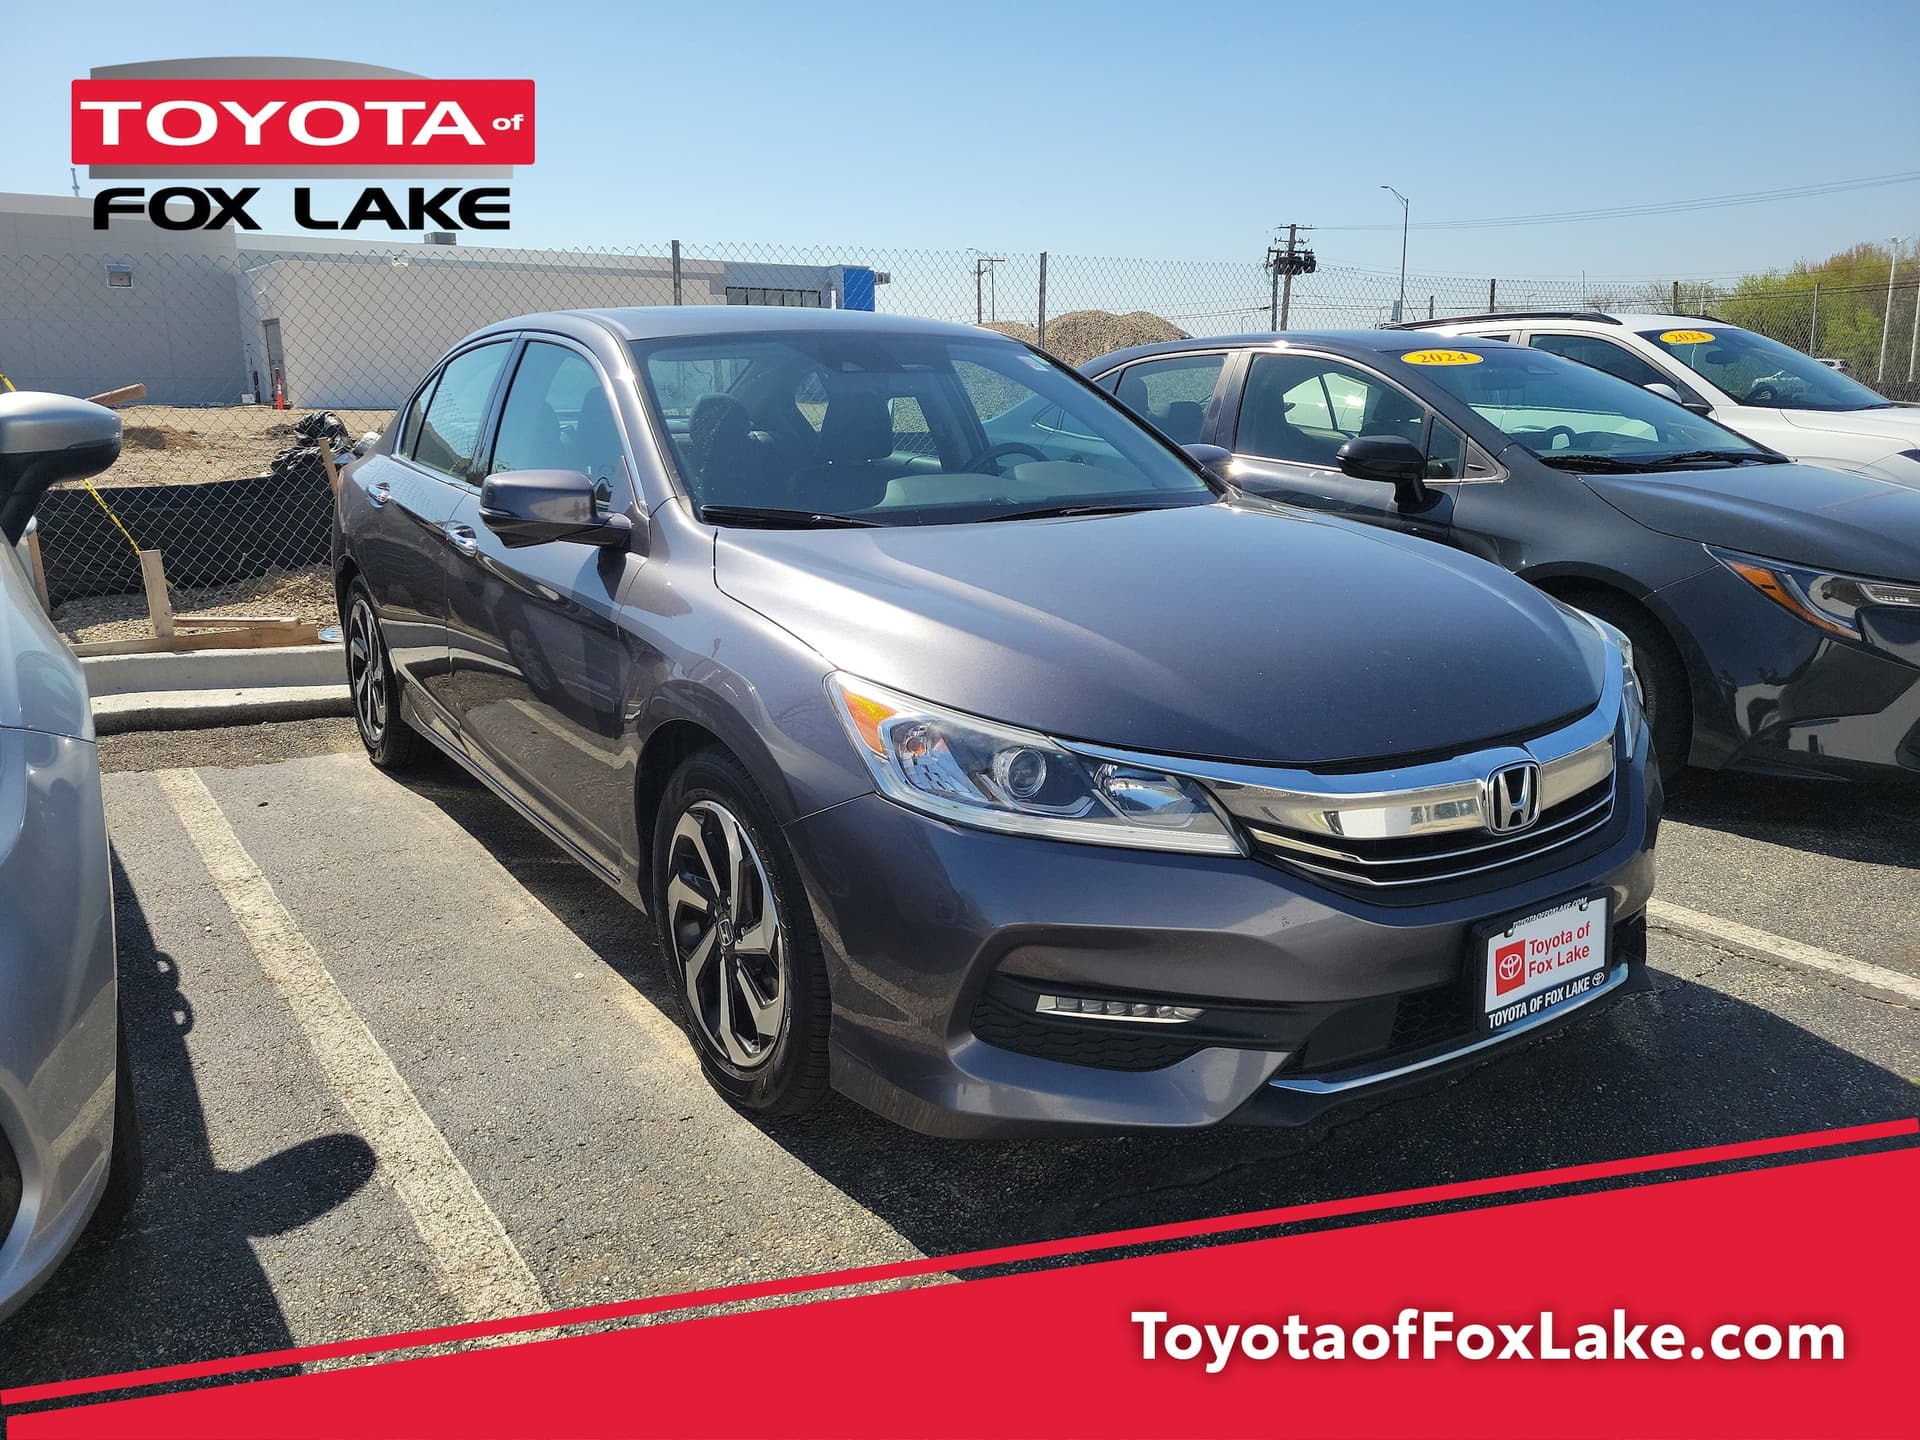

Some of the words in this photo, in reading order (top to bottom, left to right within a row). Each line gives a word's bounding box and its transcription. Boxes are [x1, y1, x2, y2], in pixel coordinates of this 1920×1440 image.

[1670, 332, 1706, 342] 2024
[1416, 352, 1469, 363] 2024
[1529, 930, 1573, 956] Toyota
[1576, 920, 1591, 939] of
[1528, 958, 1553, 978] Fox
[1557, 945, 1590, 967] Lake
[1488, 1001, 1528, 1029] TOYOTA
[1529, 994, 1543, 1013] OF
[1544, 986, 1565, 1007] FOX
[1565, 976, 1591, 998] LAKE
